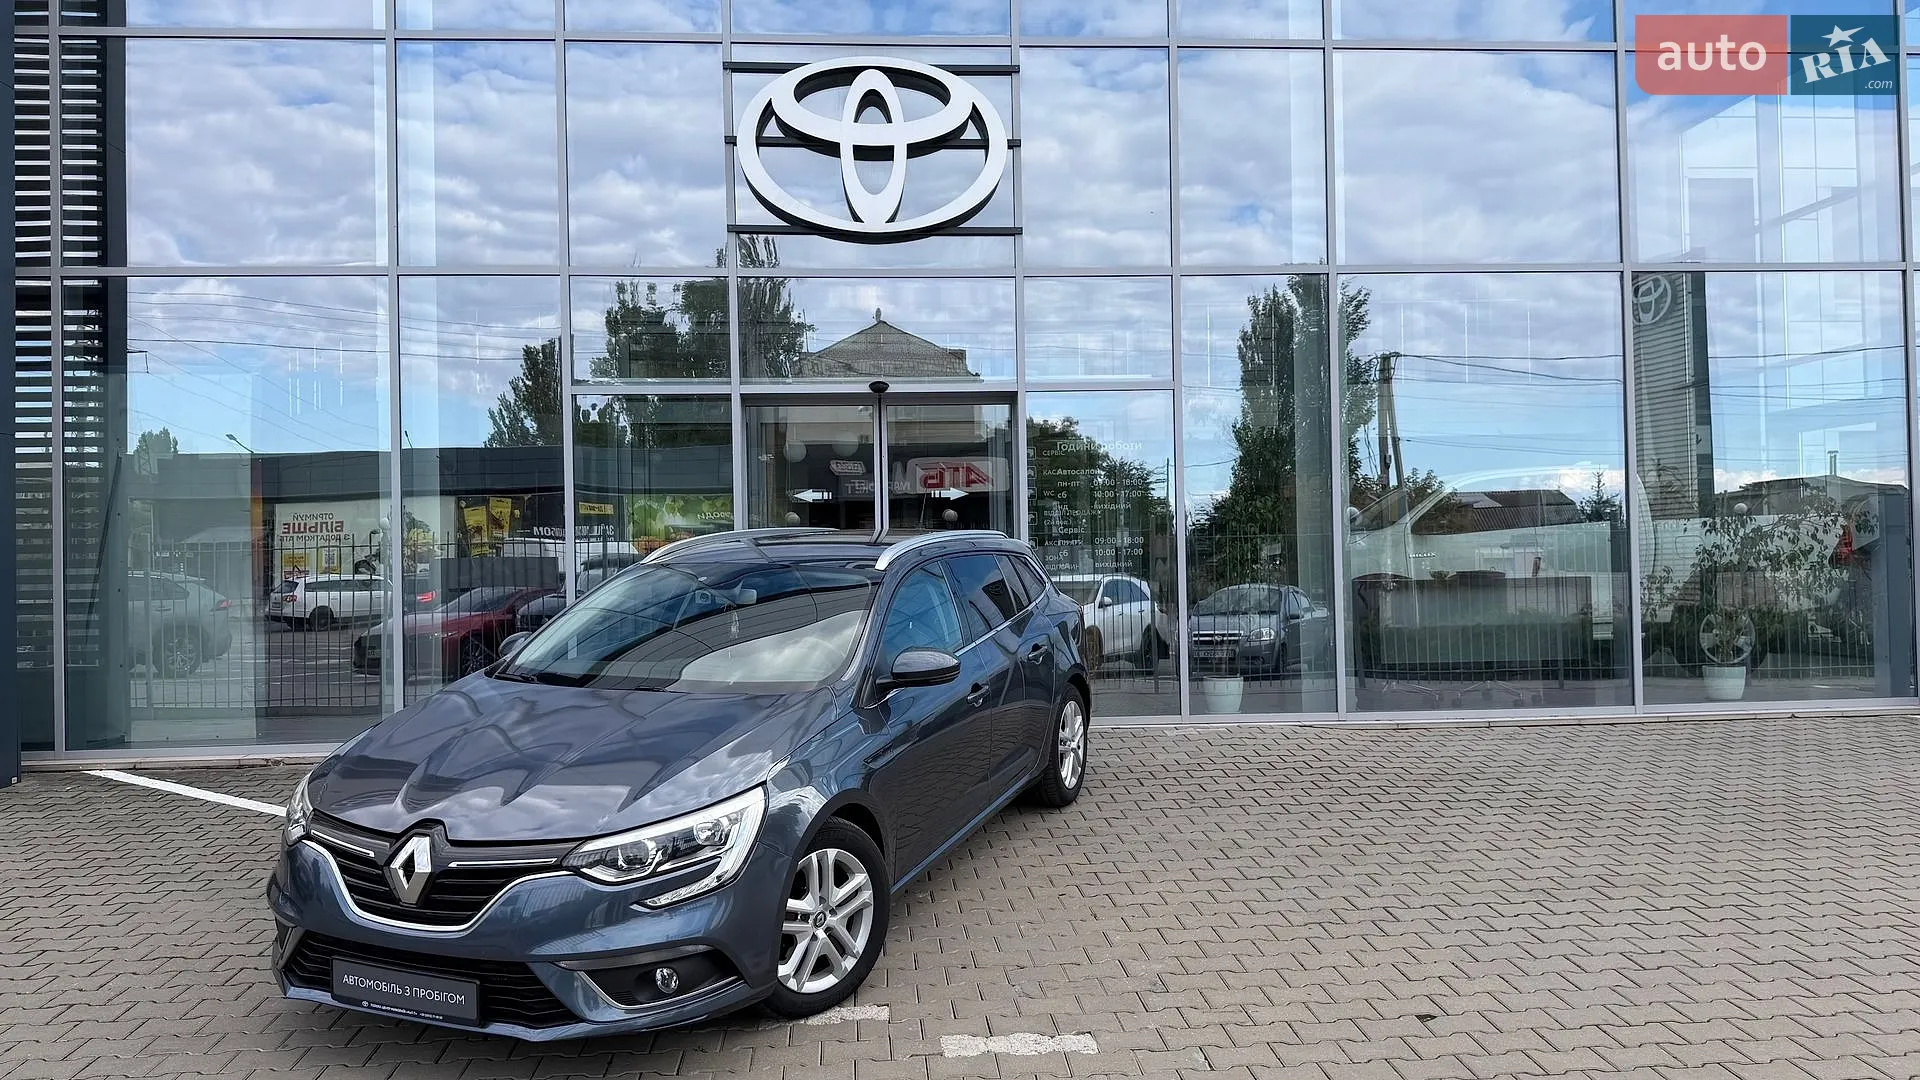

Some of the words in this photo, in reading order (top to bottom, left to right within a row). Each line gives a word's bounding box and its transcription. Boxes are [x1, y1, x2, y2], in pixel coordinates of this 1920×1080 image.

[1057, 441, 1101, 452] Години
[1123, 536, 1144, 544] 18:00
[1095, 548, 1116, 556] 10:00
[343, 974, 403, 996] АВТОМОБІЛЬ
[404, 985, 411, 997] З
[412, 987, 465, 1005] ПРОБІГОМ
